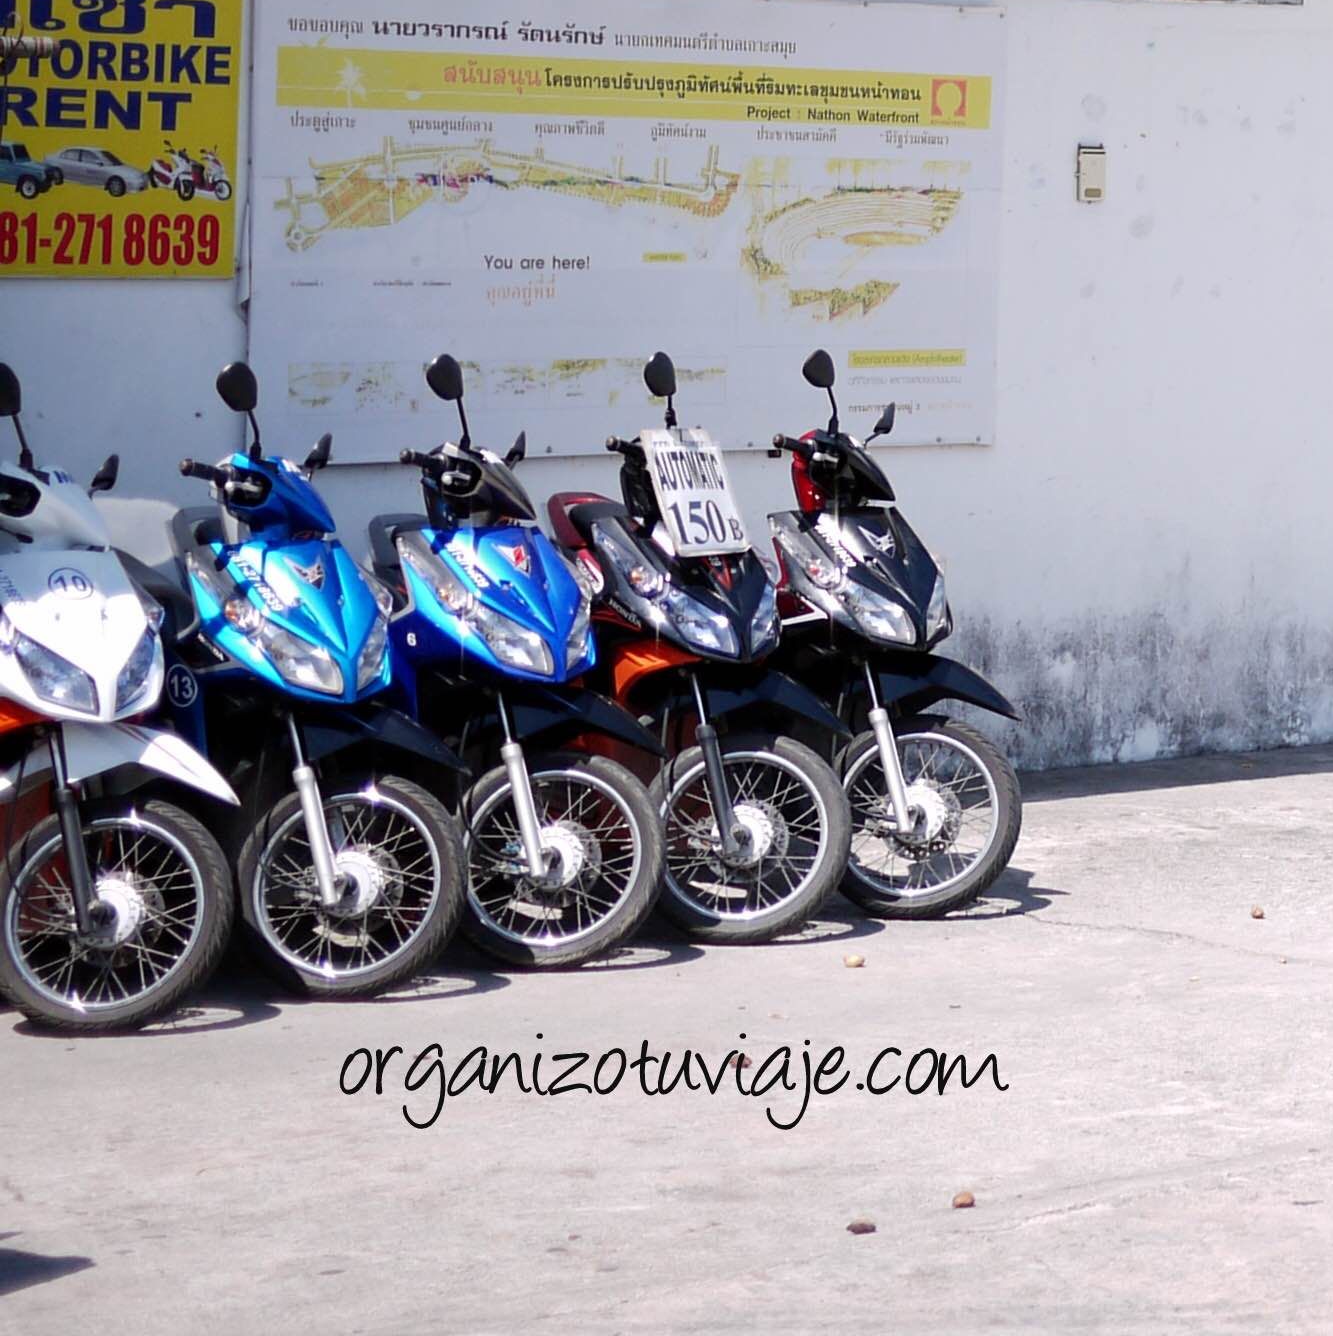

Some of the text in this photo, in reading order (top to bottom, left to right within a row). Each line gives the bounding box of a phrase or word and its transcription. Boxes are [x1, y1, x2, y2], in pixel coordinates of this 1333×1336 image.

[288, 17, 364, 40] ขอขอบคุณ
[372, 20, 509, 41] นายวรากรณ์
[517, 21, 606, 45] รัตนรักษ์
[444, 60, 542, 95] สนับสนุน
[0, 86, 192, 131] RENT
[747, 106, 791, 121] Project
[807, 108, 850, 122] Nathon
[857, 110, 920, 123] Waterfront
[123, 213, 220, 266] 8639
[484, 254, 591, 270] You are here!
[654, 450, 725, 492] AUTOMATIC
[668, 499, 726, 545] 150
[53, 574, 87, 592] 10
[406, 632, 417, 647] 6
[170, 675, 193, 700] 13
